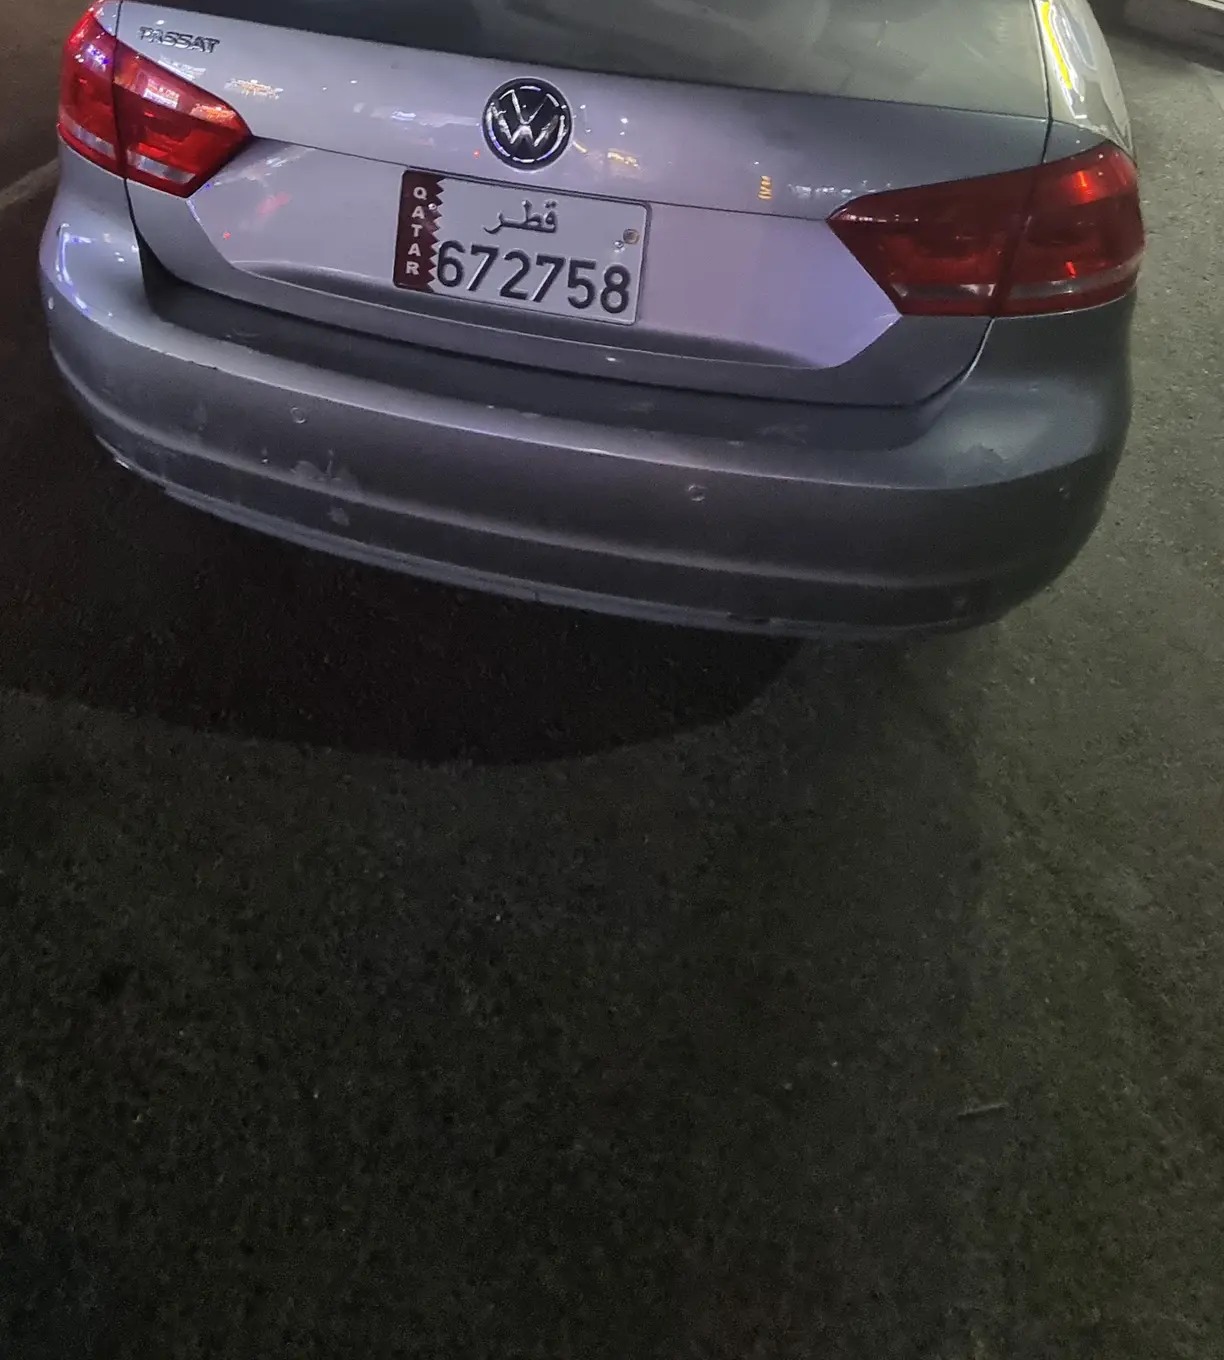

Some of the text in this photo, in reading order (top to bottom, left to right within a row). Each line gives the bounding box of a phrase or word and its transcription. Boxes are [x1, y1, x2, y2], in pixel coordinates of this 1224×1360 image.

[139, 26, 220, 54] PASSAT
[405, 186, 428, 276] QATAR
[483, 199, 559, 235] قطر
[436, 239, 631, 315] 672758
